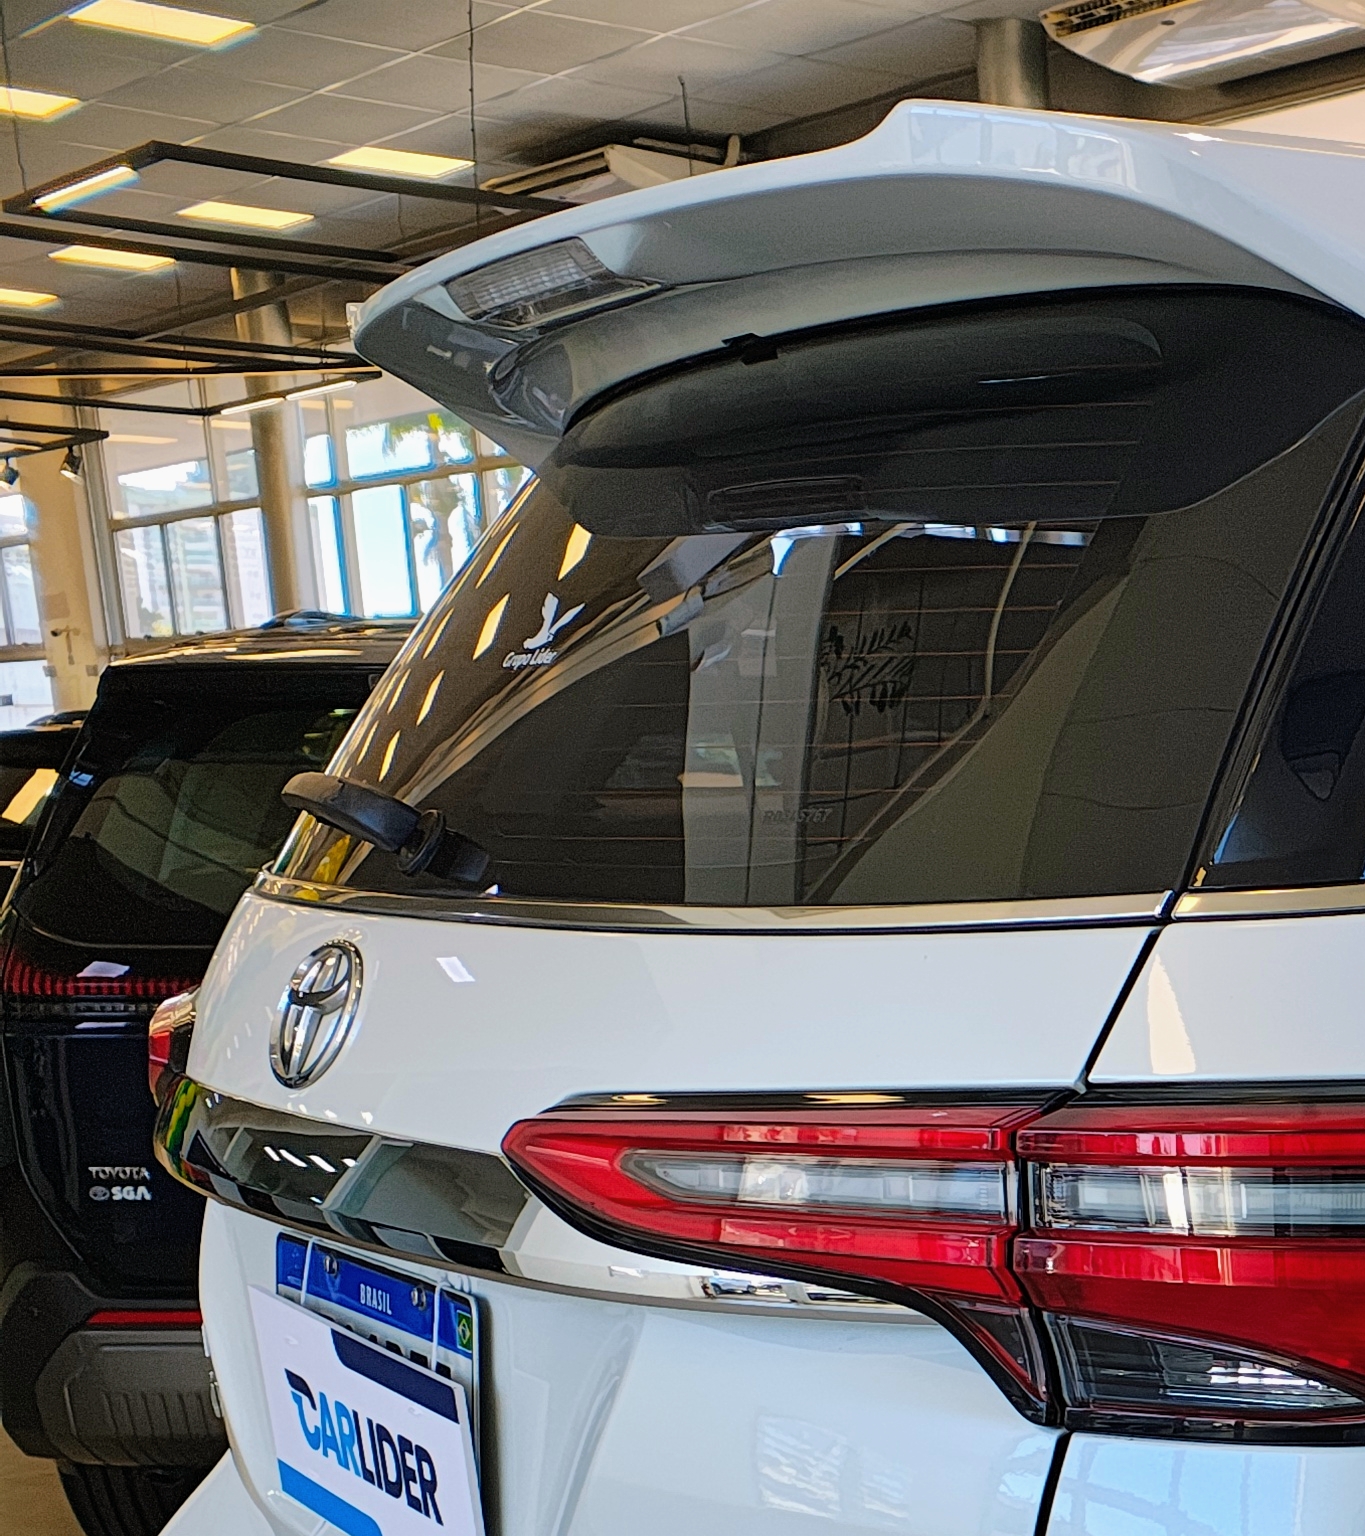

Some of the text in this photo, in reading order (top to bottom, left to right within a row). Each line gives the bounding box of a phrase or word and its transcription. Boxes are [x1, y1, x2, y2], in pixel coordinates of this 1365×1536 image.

[87, 1166, 151, 1181] TOYOTA
[111, 1185, 153, 1201] SGA
[360, 1283, 393, 1315] BRASIL
